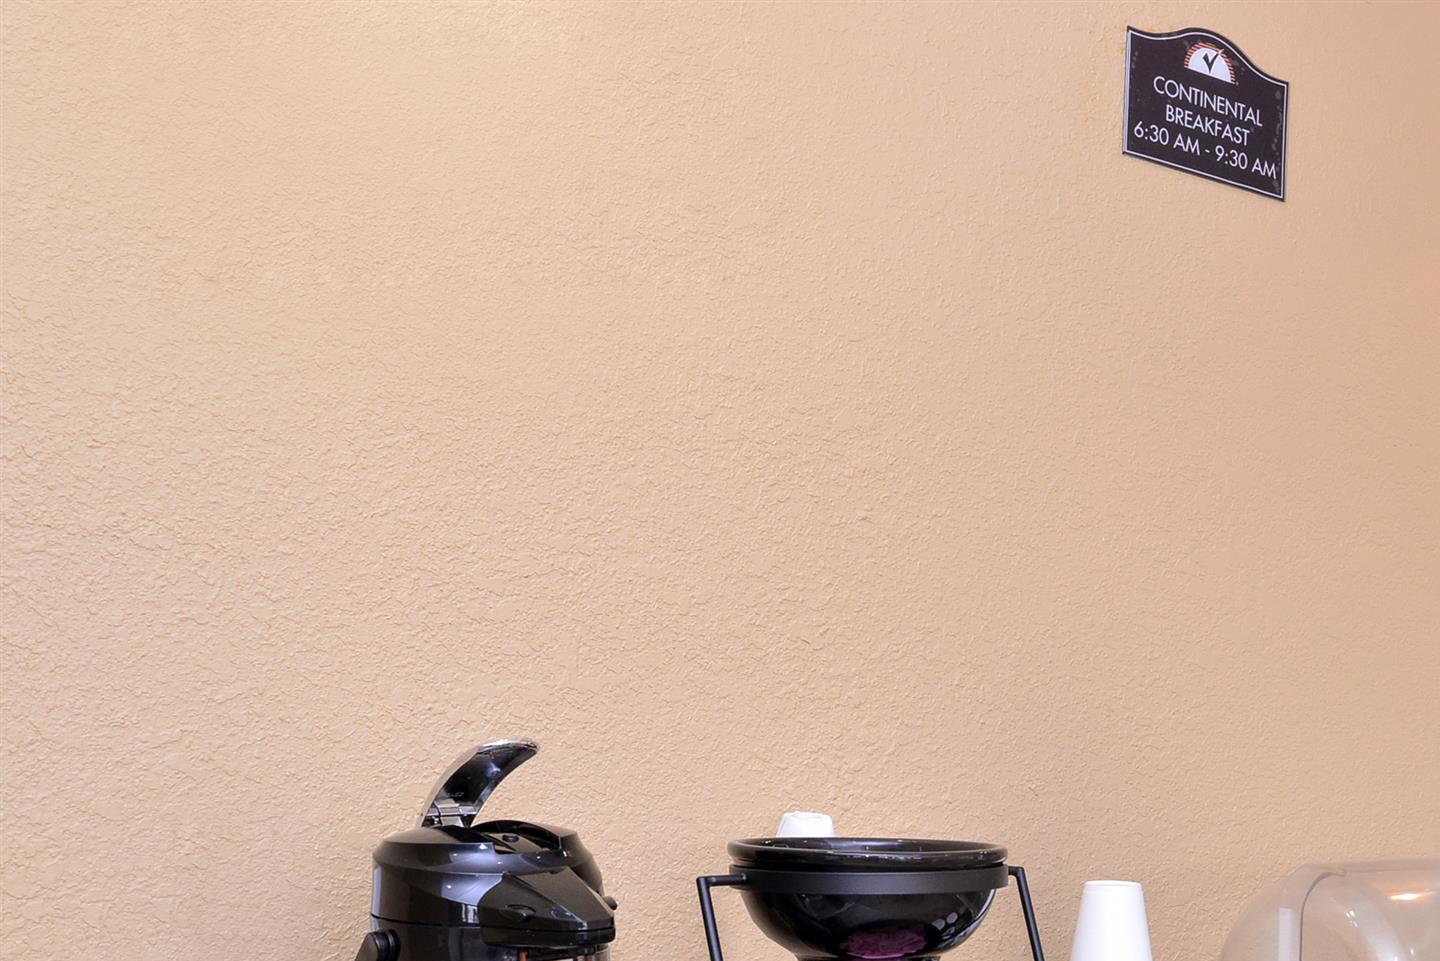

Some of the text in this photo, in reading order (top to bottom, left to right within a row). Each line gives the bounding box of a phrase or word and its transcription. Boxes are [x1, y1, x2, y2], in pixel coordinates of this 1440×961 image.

[1153, 75, 1263, 127] CONTINENTAL
[1166, 104, 1250, 146] BREAKFAST
[1134, 121, 1169, 145] 6:30
[1173, 133, 1200, 156] AM
[1215, 145, 1248, 170] 9:30
[1251, 158, 1277, 179] AM
